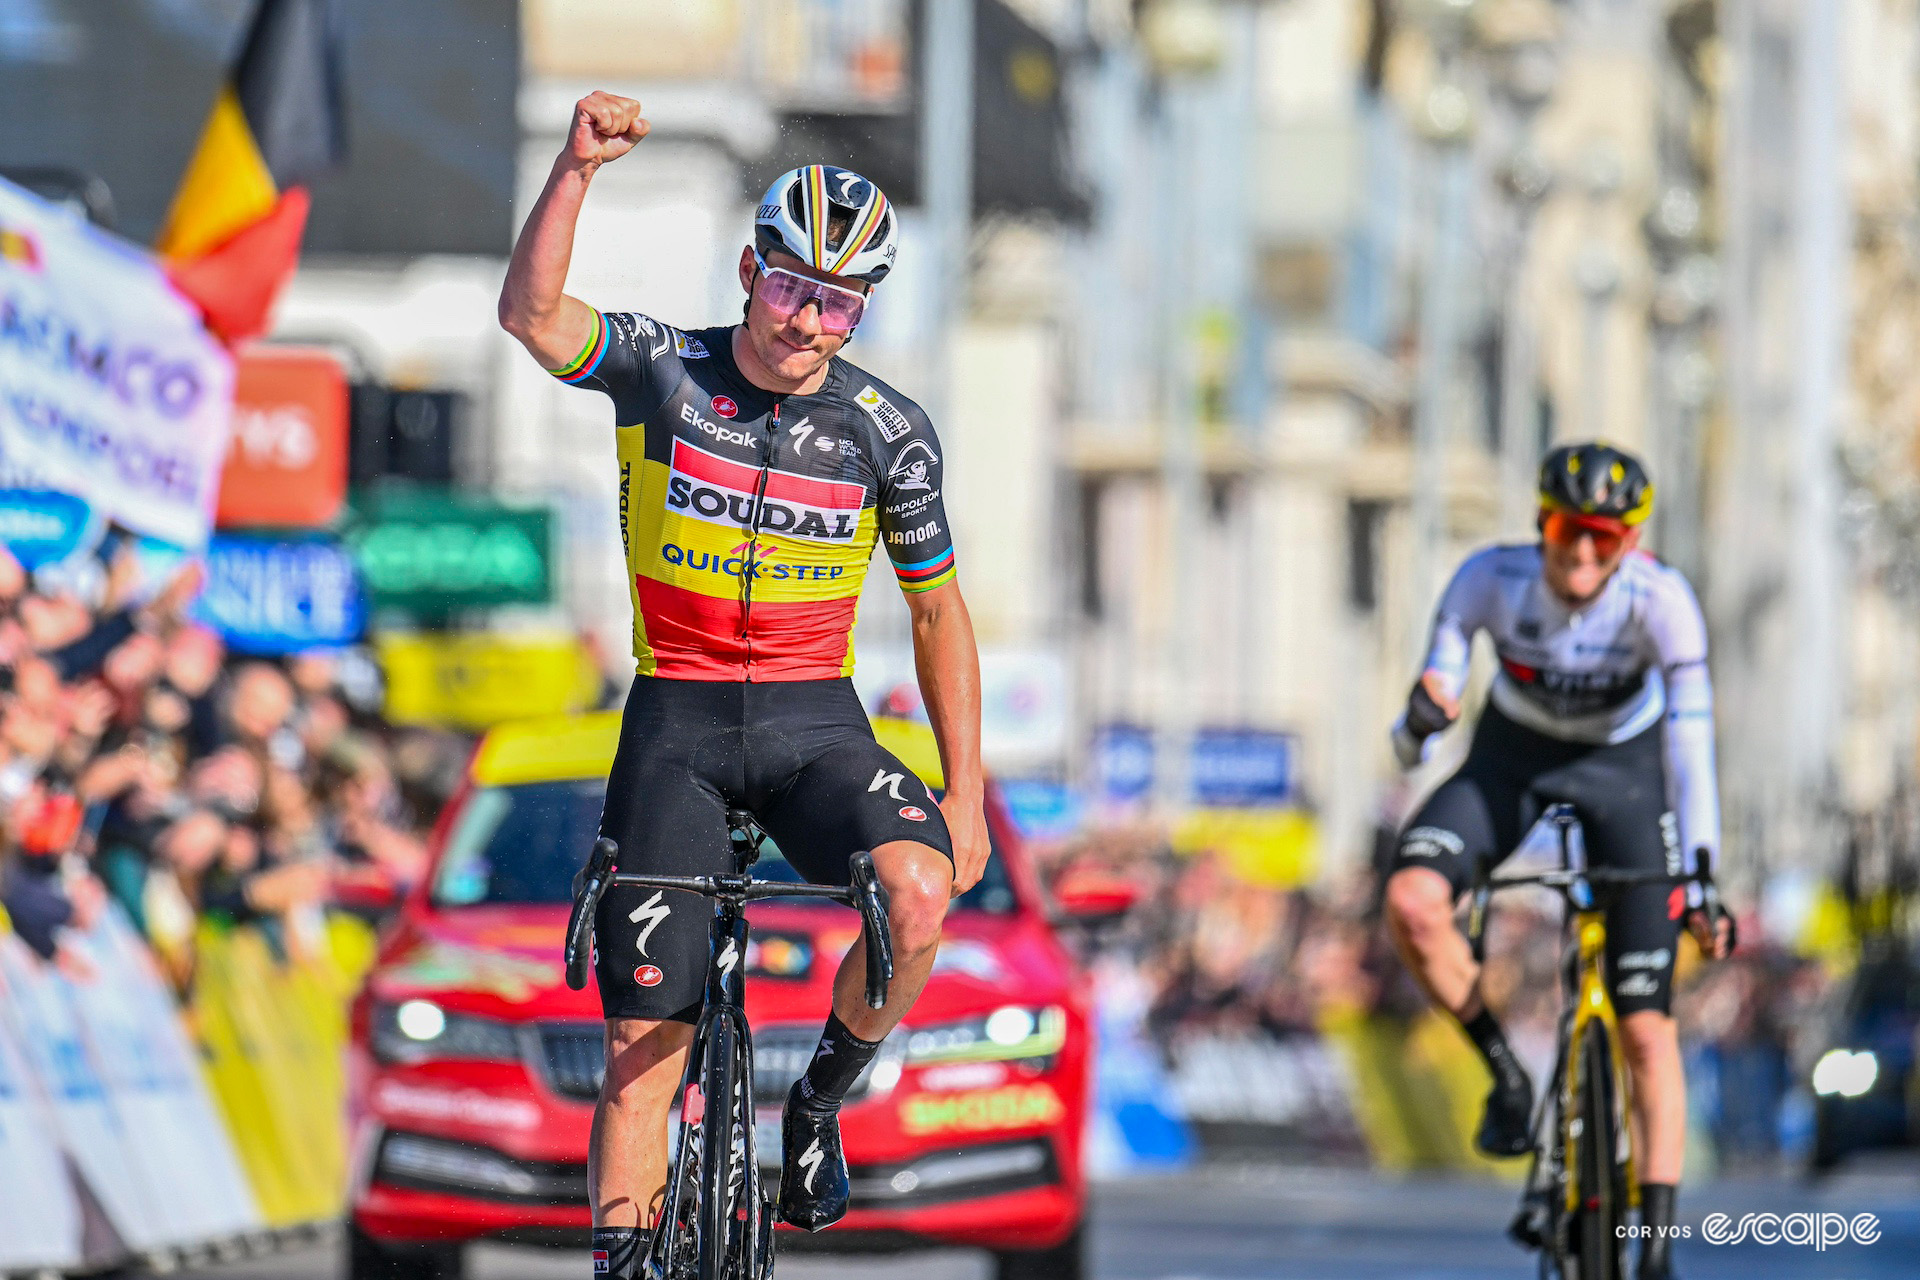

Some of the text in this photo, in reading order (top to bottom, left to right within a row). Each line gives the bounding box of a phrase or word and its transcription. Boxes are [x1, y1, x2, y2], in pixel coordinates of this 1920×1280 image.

[680, 402, 758, 449] Ekopak
[873, 406, 901, 438] JOGGER
[879, 401, 909, 431] SAFETY
[838, 438, 854, 446] UCI
[619, 461, 631, 558] SOUDAL
[667, 477, 855, 539] SOUDAL
[885, 488, 940, 514] NAPOLEON
[901, 505, 927, 518] SPORTS
